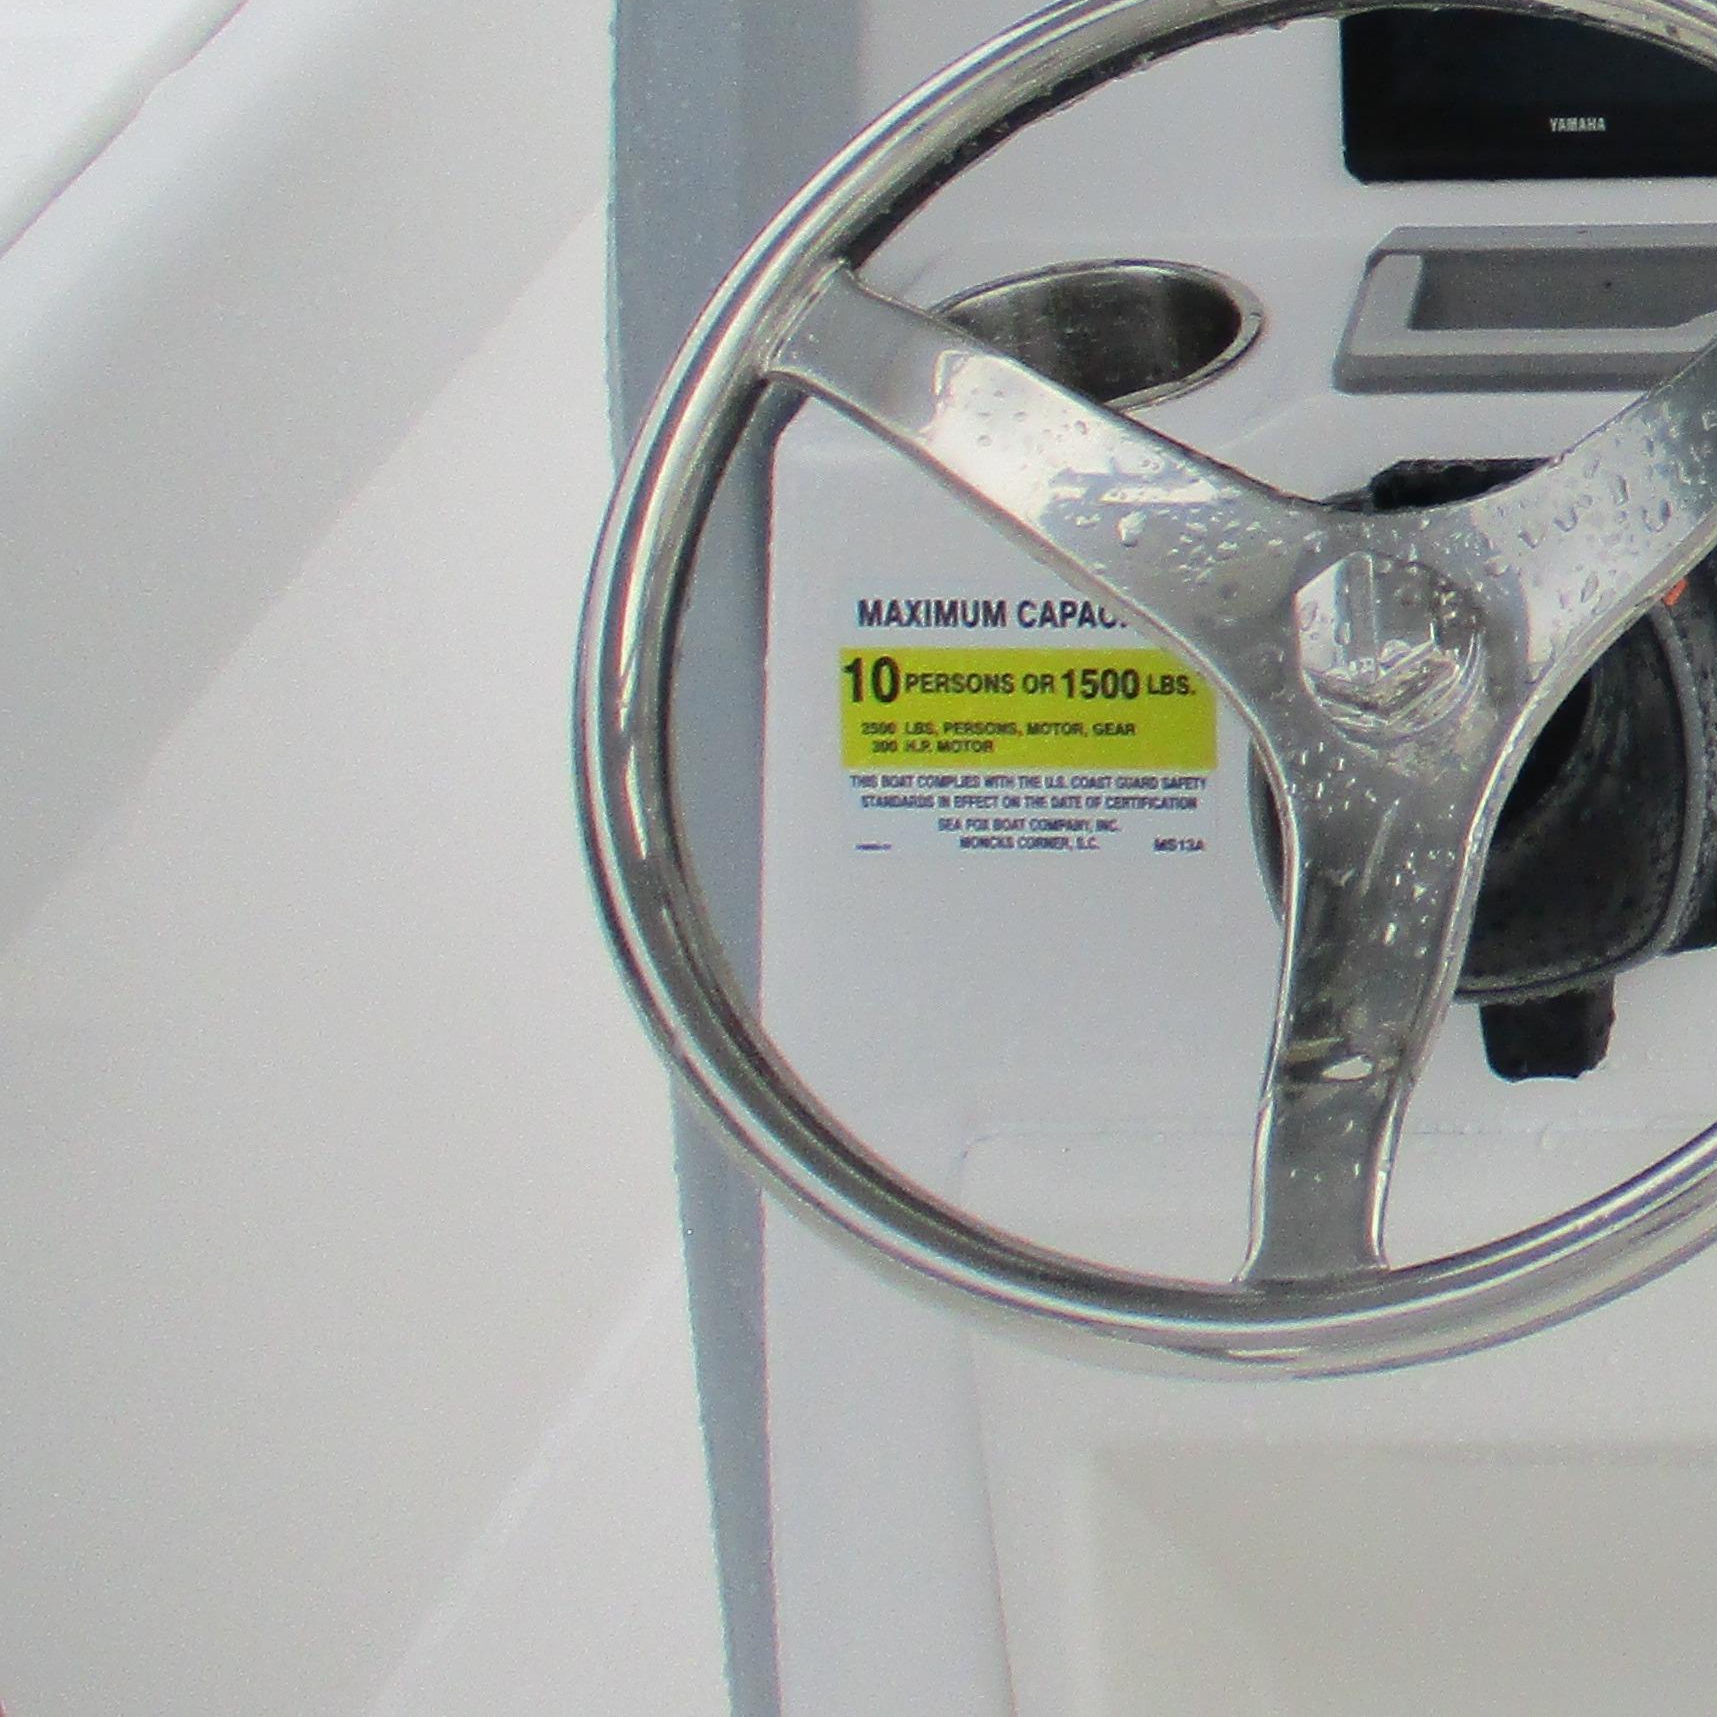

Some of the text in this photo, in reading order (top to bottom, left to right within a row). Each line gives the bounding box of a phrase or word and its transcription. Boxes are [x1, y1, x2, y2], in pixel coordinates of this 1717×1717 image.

[1550, 117, 1606, 133] YAMAHA
[857, 599, 1128, 629] MAXIMUM CAPAC
[844, 655, 1197, 704] 10 PERSONS OR 1500 LBS.
[1092, 722, 1136, 735] GEAR
[936, 740, 994, 753] MOTOR
[850, 775, 877, 789] THIS
[881, 775, 912, 789] BOAT
[917, 775, 980, 789] COMPLIES
[984, 775, 1014, 789] WITH
[1019, 775, 1041, 789] THE
[1070, 775, 1110, 790] COAST
[1114, 775, 1158, 790] GUARD
[1161, 775, 1206, 790] SAFETY
[861, 795, 1199, 810] STANDARDS IN EFFECT ON THE DATE OF CERTIFICATION
[938, 818, 961, 831] SEA
[965, 818, 989, 831] FOX
[992, 818, 1024, 832] BOAT
